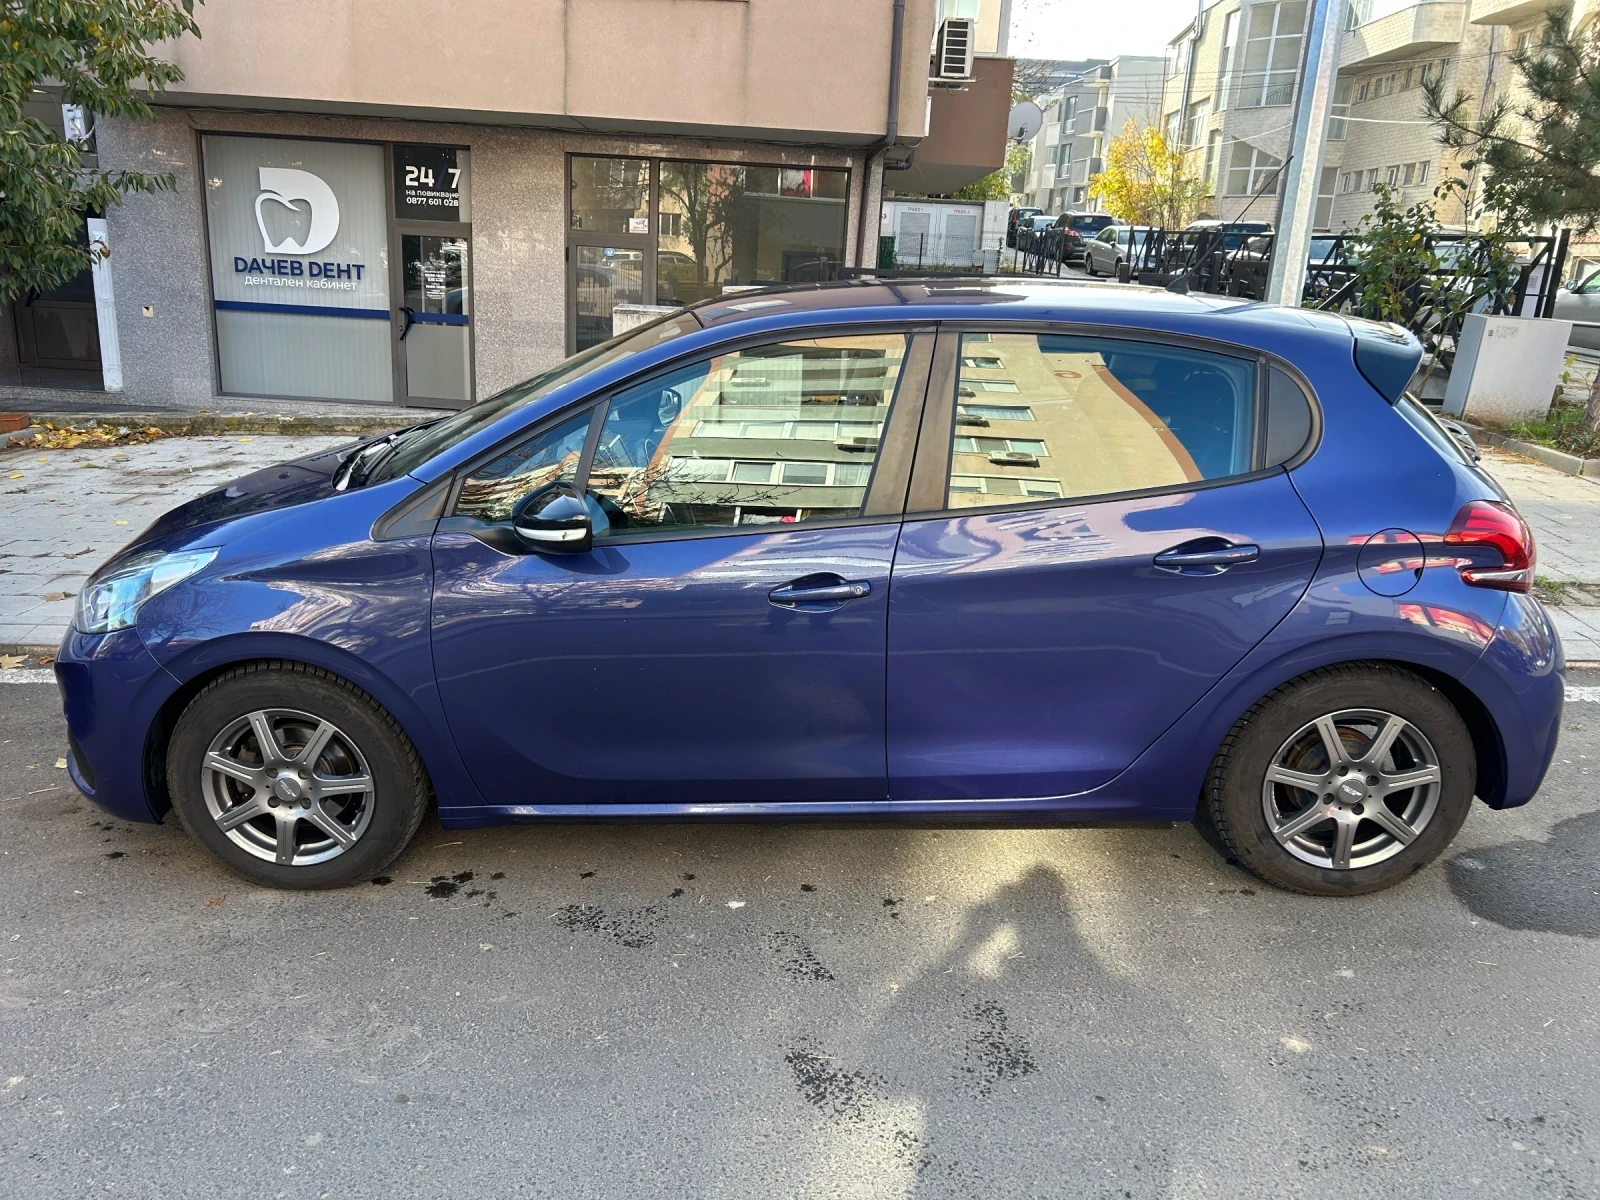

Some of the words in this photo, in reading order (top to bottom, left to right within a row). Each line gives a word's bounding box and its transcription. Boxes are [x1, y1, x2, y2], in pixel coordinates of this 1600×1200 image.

[417, 190, 459, 198] повикване
[406, 197, 427, 205] 0877
[428, 198, 442, 206] 601
[443, 199, 459, 207] 028
[244, 276, 303, 288] дентален
[306, 279, 358, 291] кабинет
